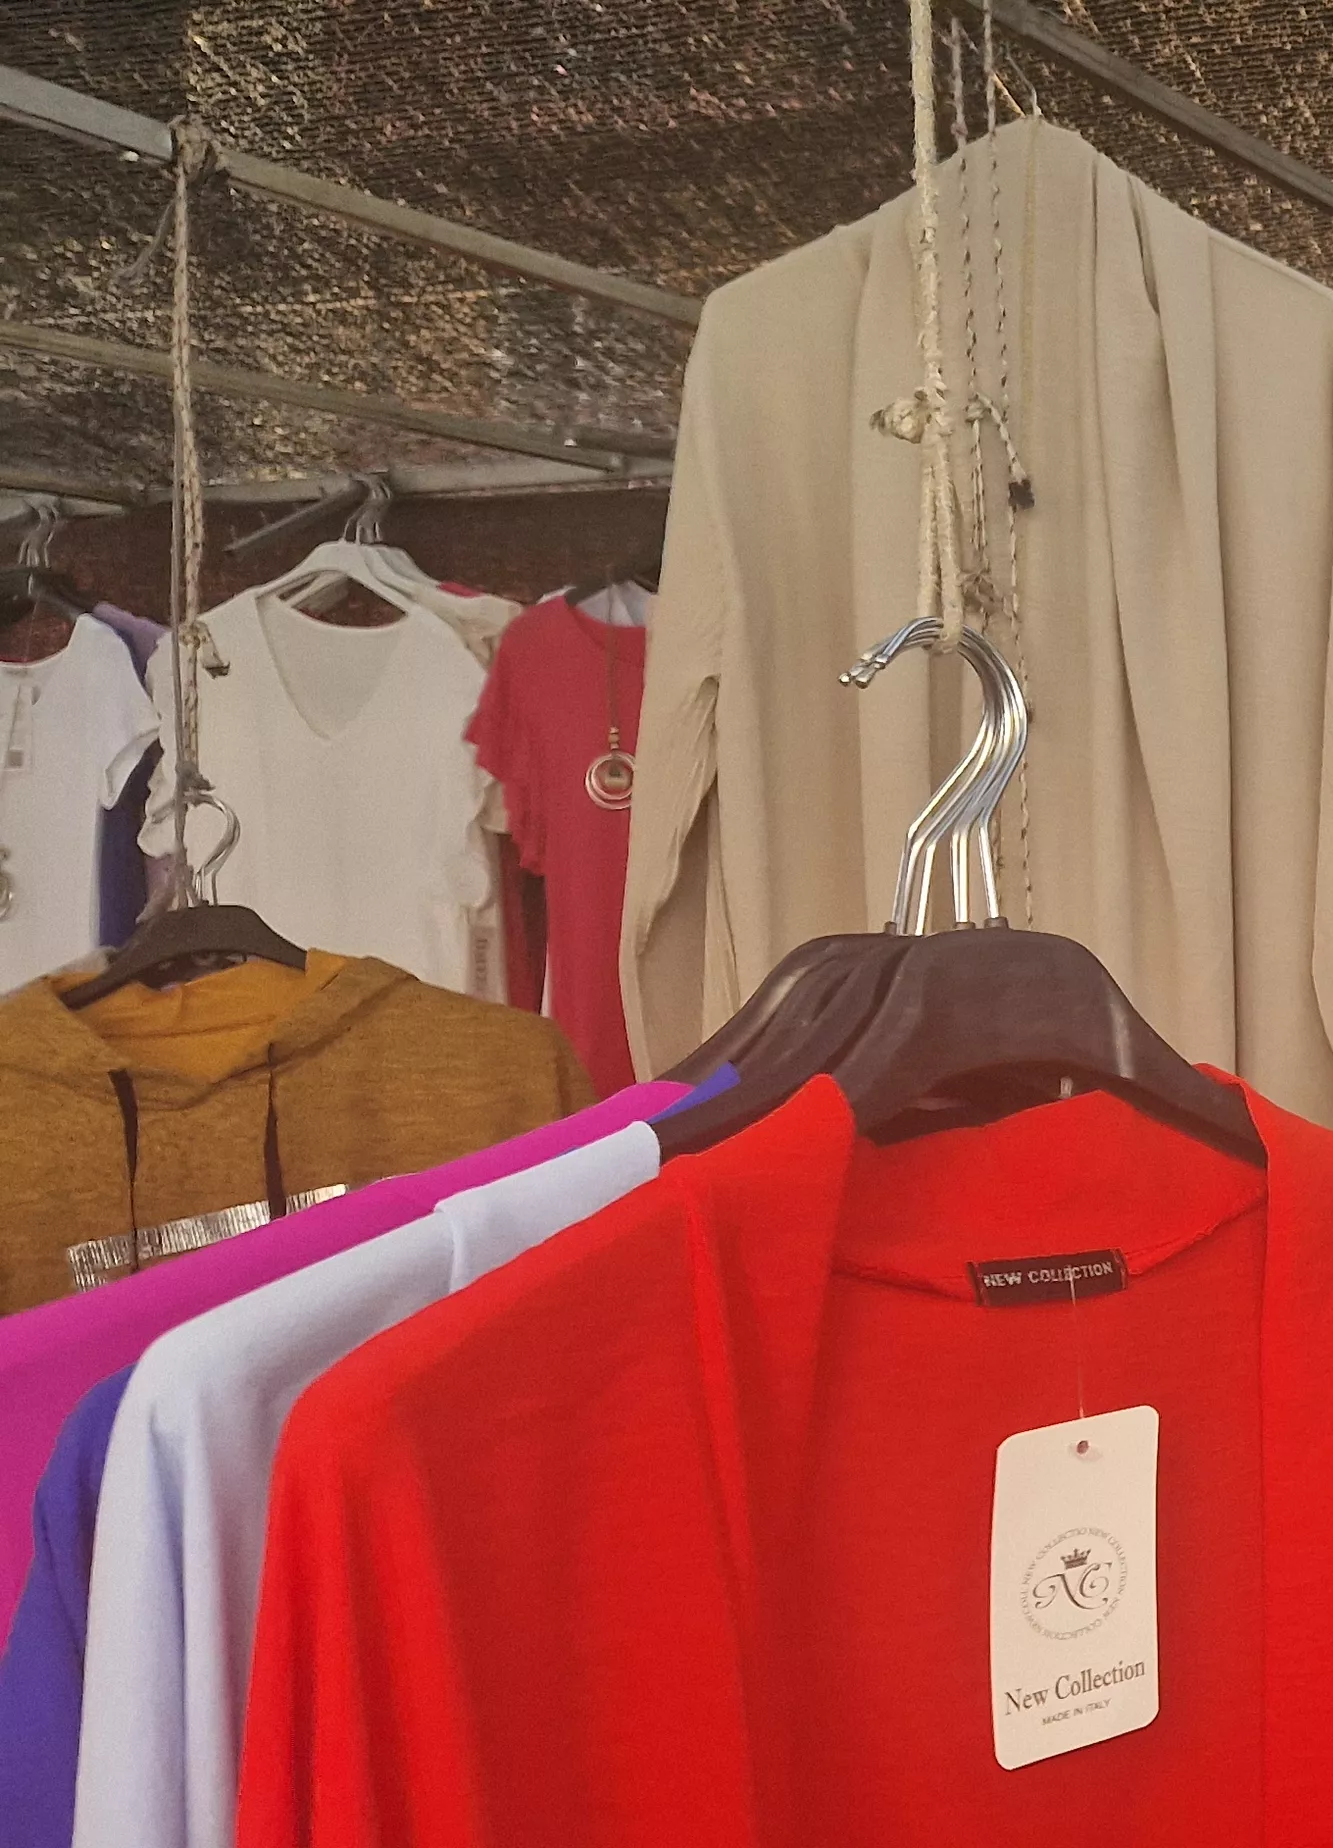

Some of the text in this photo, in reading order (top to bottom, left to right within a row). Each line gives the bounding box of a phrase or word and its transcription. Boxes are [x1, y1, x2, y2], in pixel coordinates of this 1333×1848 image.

[983, 1262, 1114, 1288] NEW COLLECTION
[1004, 1660, 1146, 1716] New Collection
[1042, 1698, 1112, 1725] MADE IN ITALY
